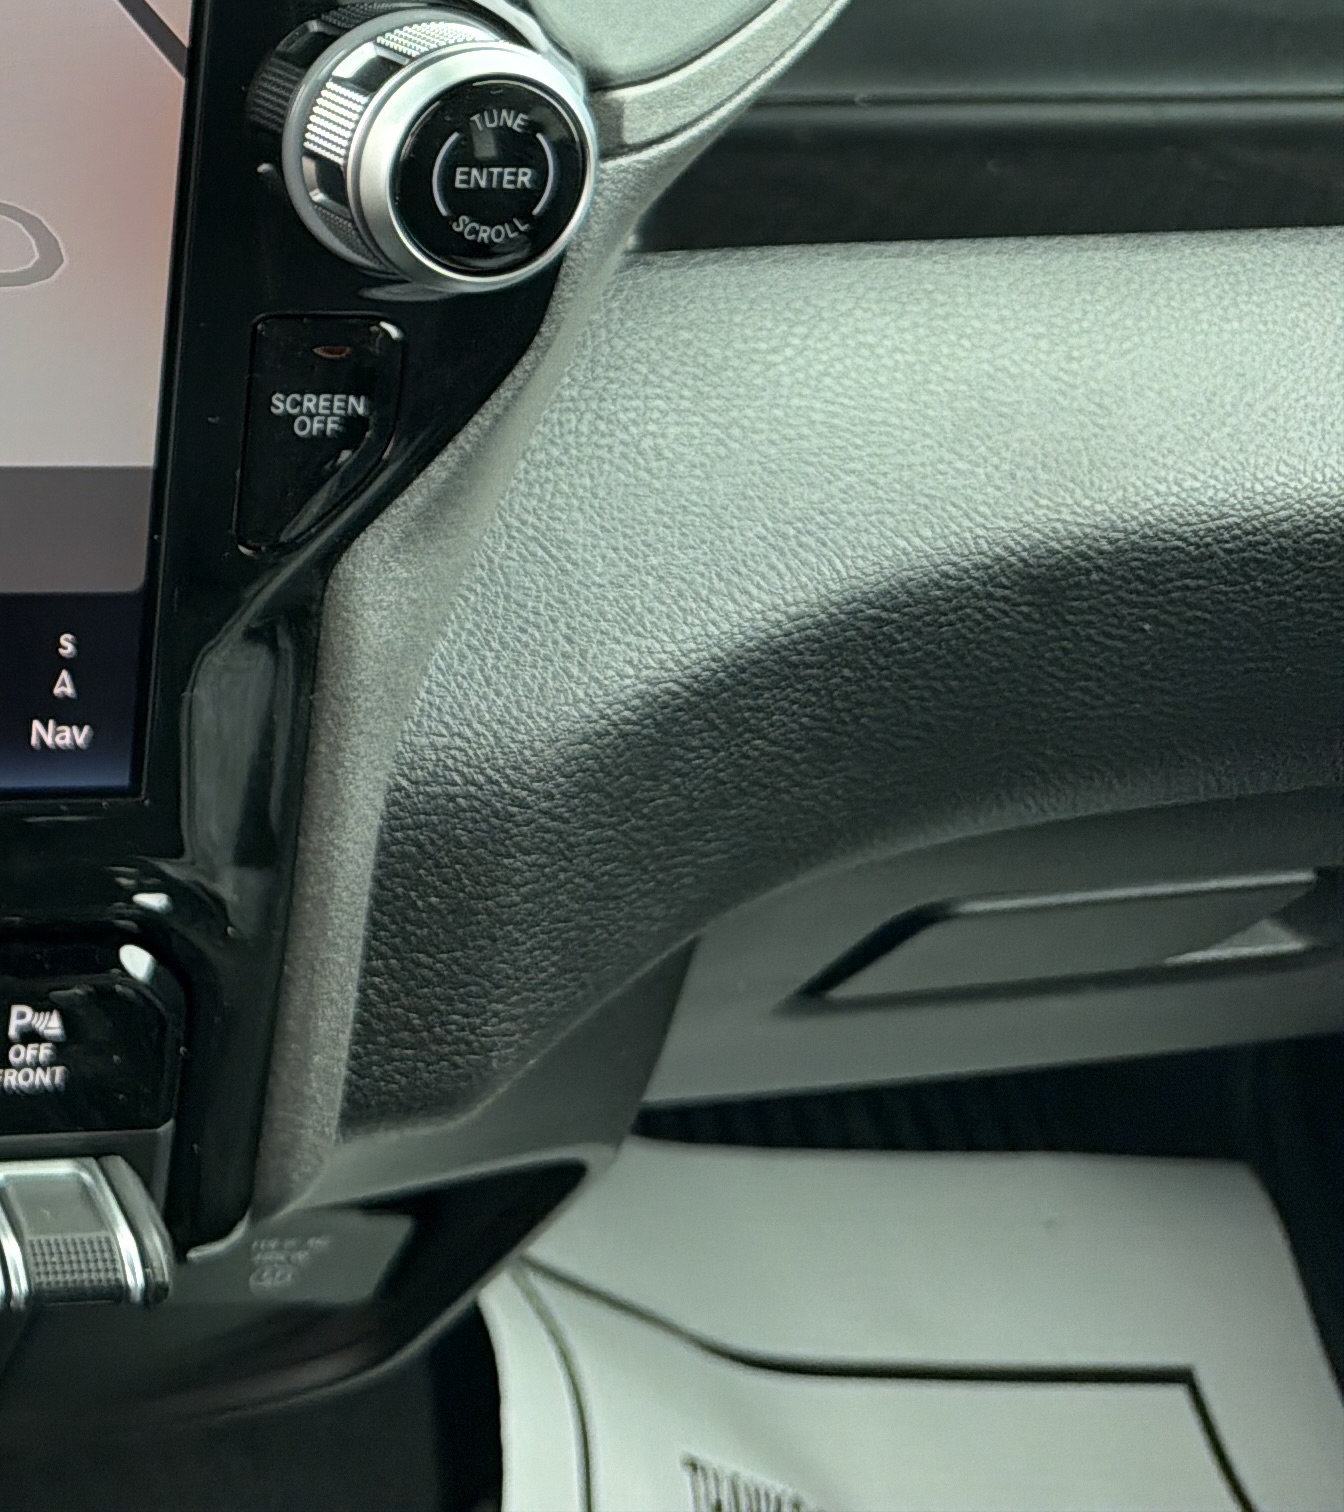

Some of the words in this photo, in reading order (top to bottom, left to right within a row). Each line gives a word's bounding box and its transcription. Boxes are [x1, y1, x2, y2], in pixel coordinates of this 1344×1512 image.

[470, 109, 529, 133] TUNE
[454, 166, 533, 190] ENTER
[451, 215, 530, 244] SCROLL
[270, 393, 366, 416] SCREEN
[293, 416, 341, 438] OFF
[58, 633, 78, 659] S
[30, 718, 94, 750] Nav
[8, 1043, 54, 1067] OFF
